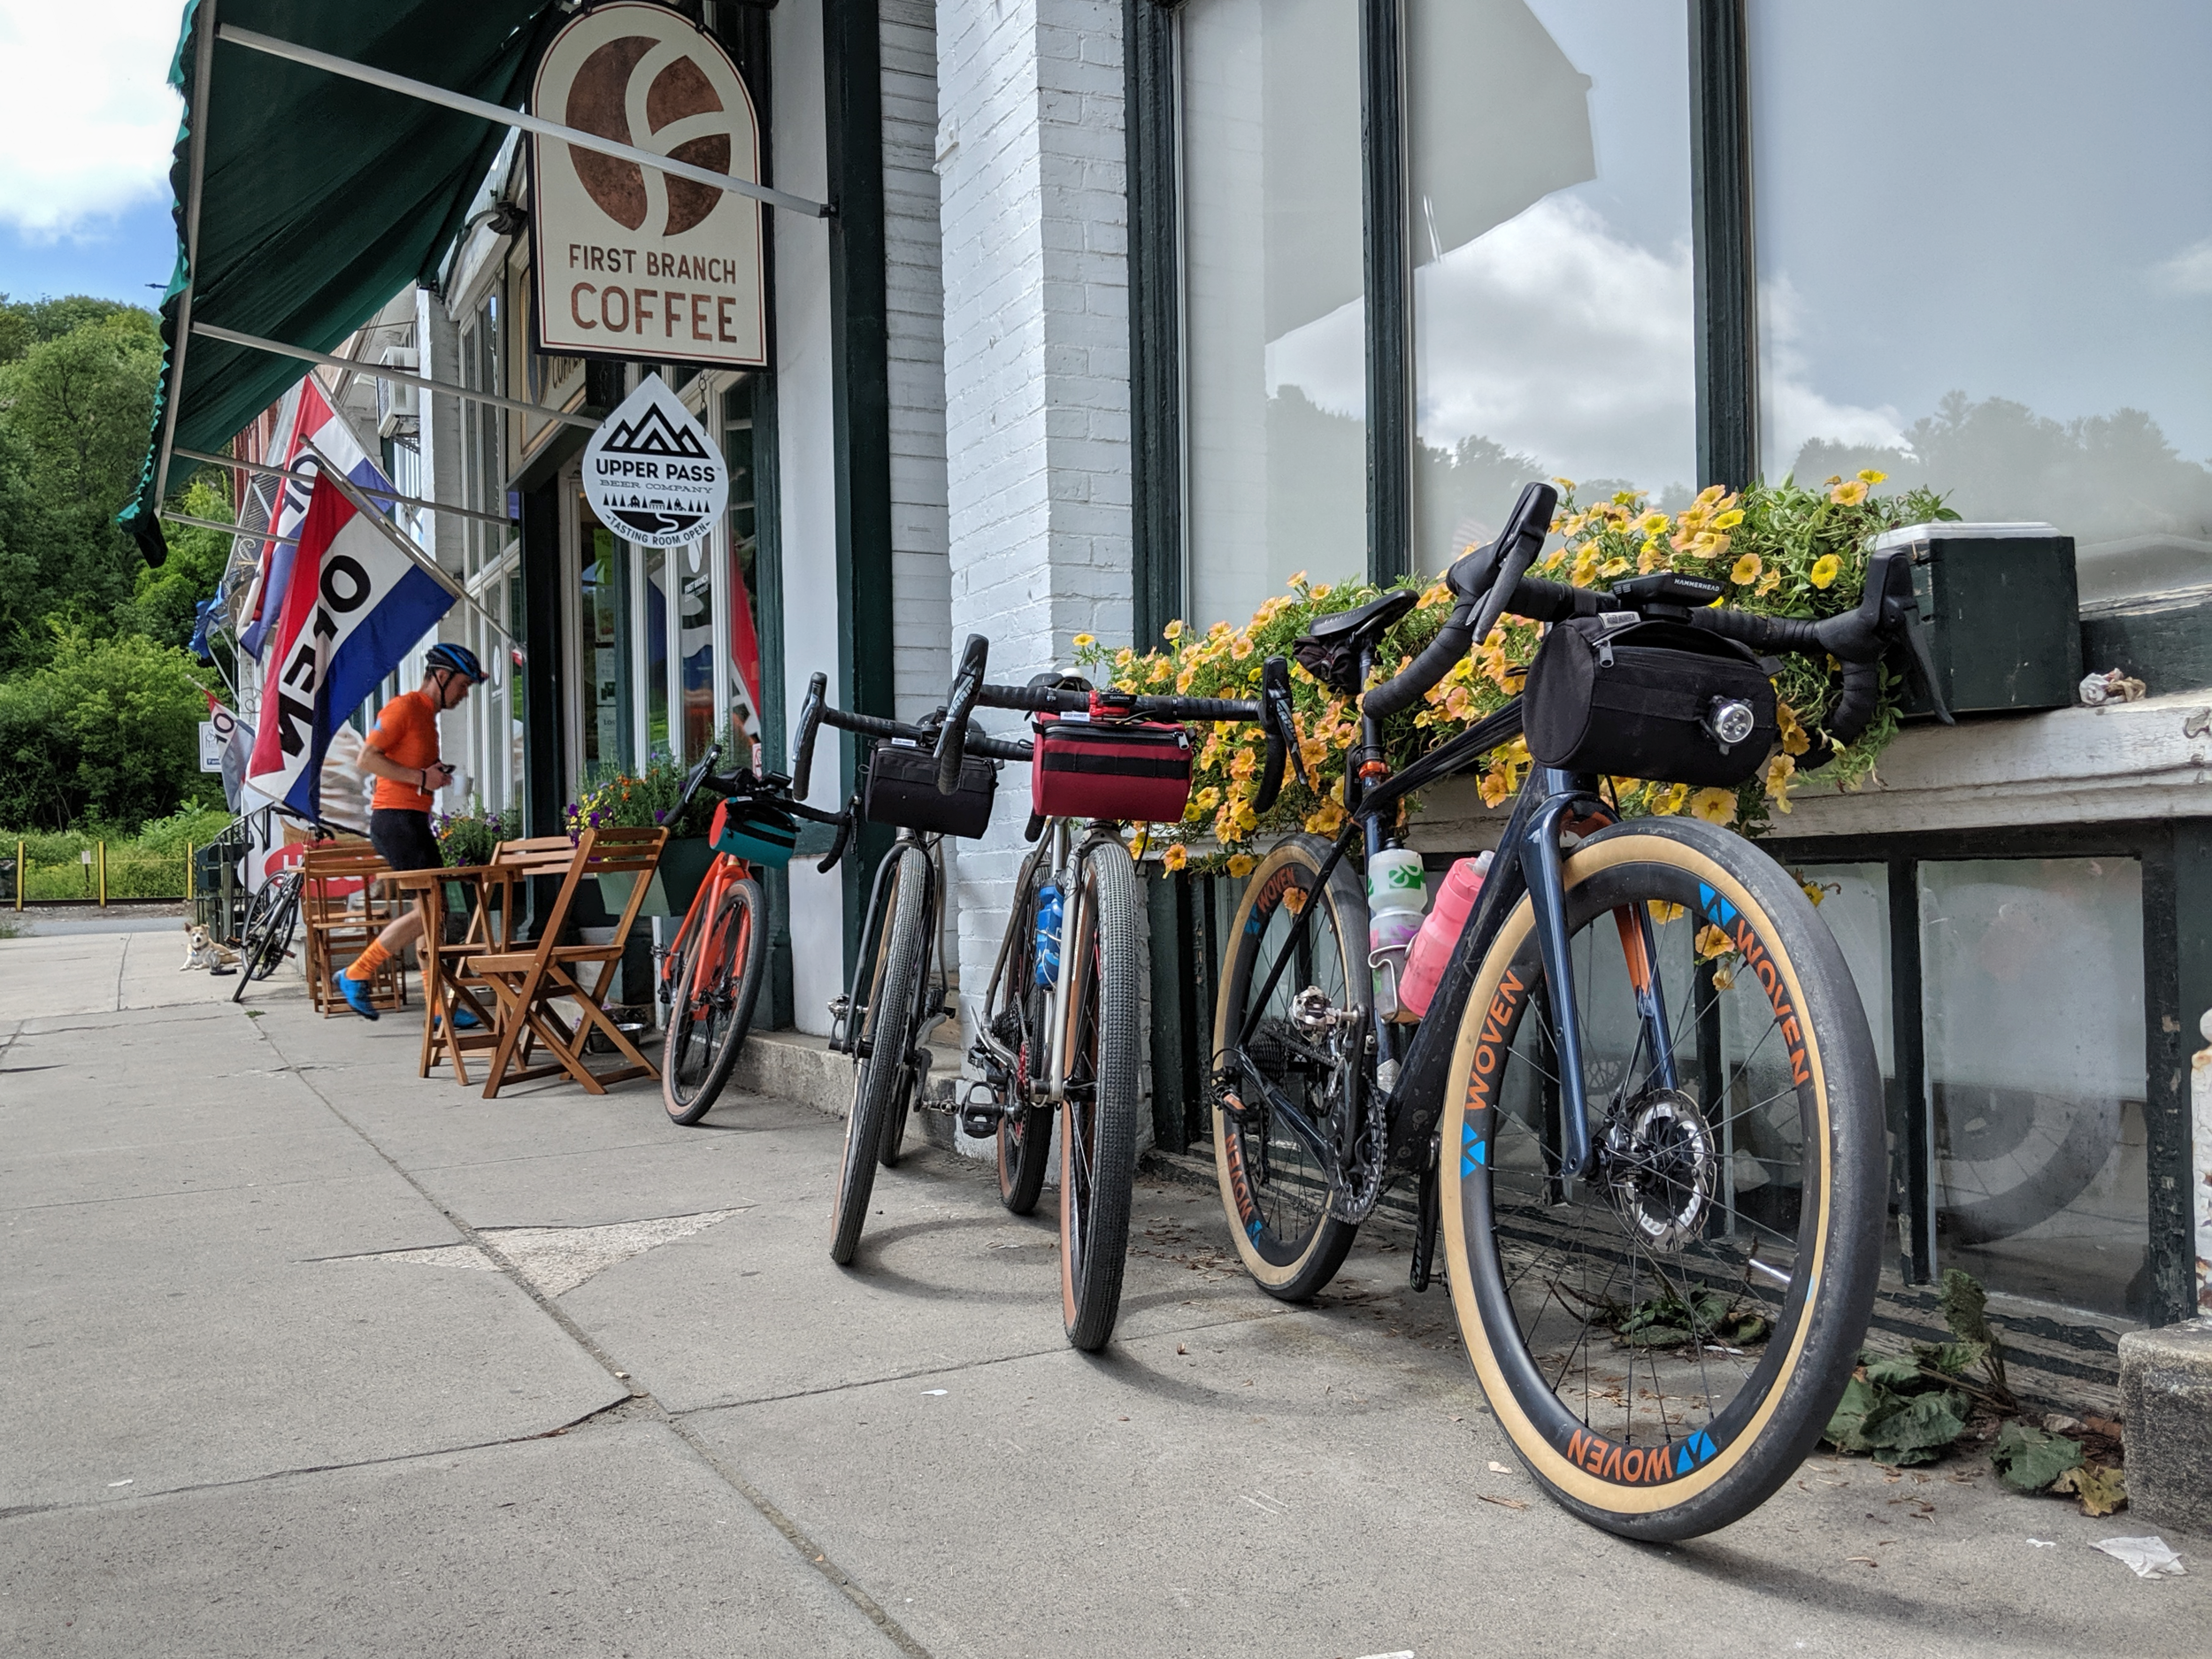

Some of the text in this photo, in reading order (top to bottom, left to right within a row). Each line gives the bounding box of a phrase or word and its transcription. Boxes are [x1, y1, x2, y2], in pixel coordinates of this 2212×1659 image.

[569, 243, 736, 284] FIRST BRANCH
[571, 281, 738, 344] COFFEE
[595, 457, 716, 483] UPPER PASS
[599, 479, 713, 494] BEER COMPANY
[610, 516, 706, 546] TASTING ROOM OPEN
[1673, 578, 1720, 592] HAMMERHEAD
[1277, 702, 1297, 740] SRA
[1256, 866, 1295, 913] WOVEN
[1736, 918, 1810, 1088] WOVEN
[1465, 970, 1525, 1110] WOVEN
[1225, 1133, 1254, 1227] WOVEN
[1567, 1428, 1674, 1484] WOVEN
